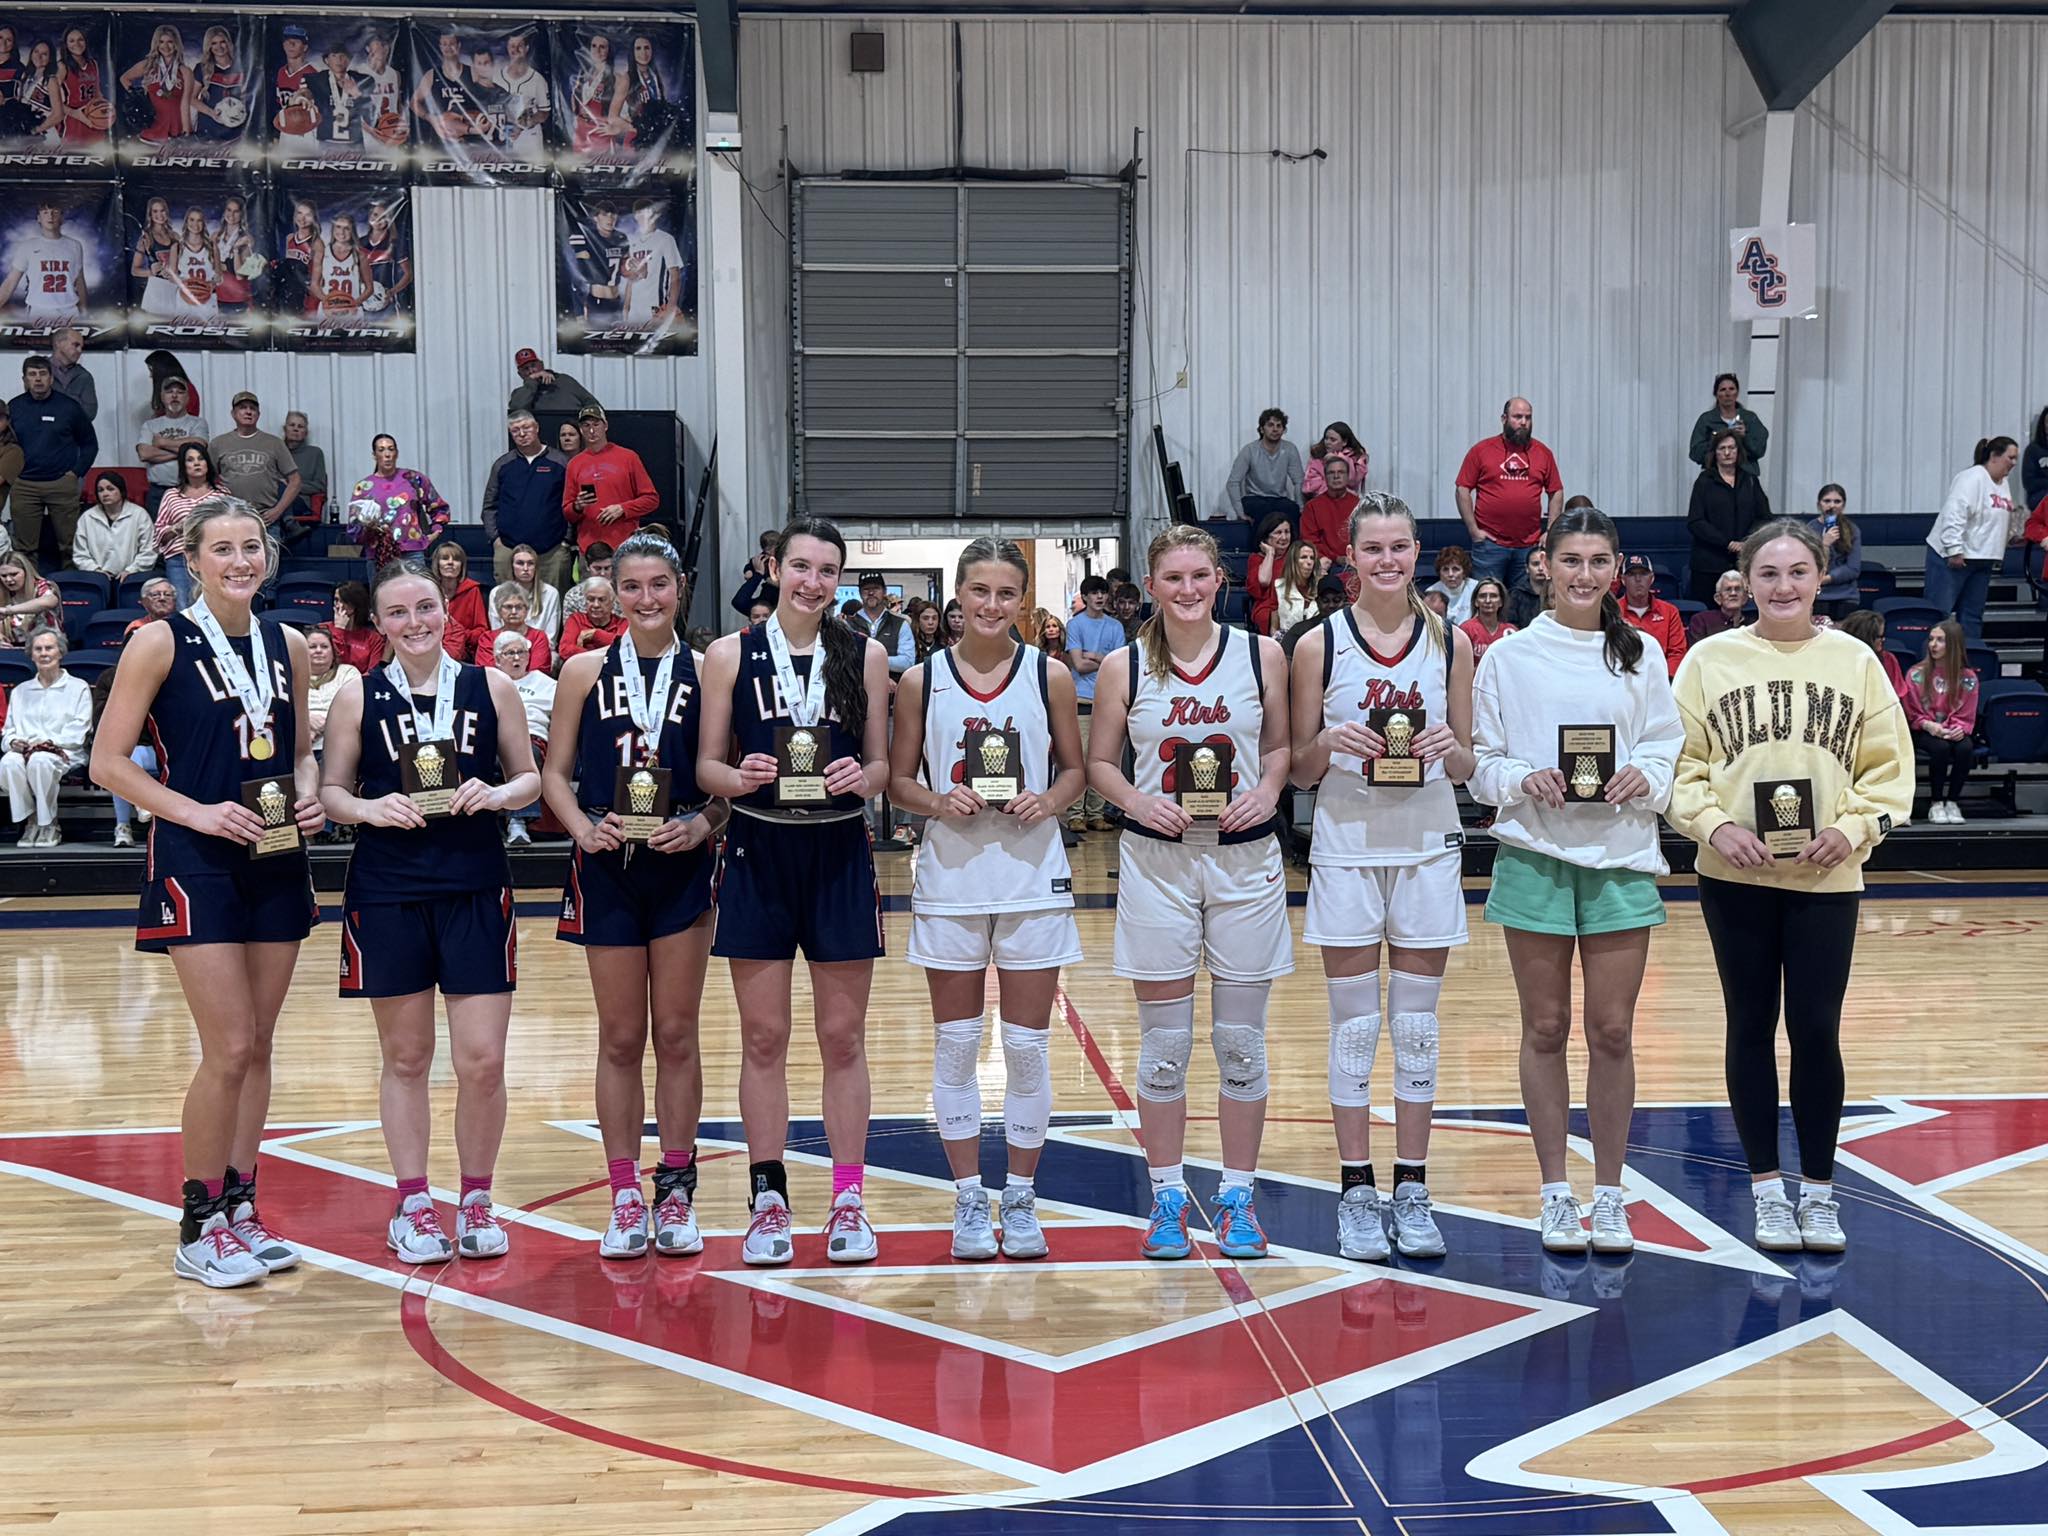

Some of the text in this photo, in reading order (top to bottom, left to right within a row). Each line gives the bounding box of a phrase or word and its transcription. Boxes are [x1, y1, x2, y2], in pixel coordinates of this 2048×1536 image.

[0, 154, 104, 167] RISTER
[132, 156, 255, 169] BURNETT
[281, 159, 397, 171] CARSON
[422, 161, 548, 173] EDWARDS
[571, 164, 682, 175] GATIN
[40, 260, 70, 272] KIRK
[42, 274, 67, 293] 22
[145, 325, 252, 337] ROSE
[286, 328, 405, 338] SULTAN
[1357, 678, 1424, 709] Kirk
[1162, 695, 1231, 727] Kirk
[161, 901, 176, 925] LA
